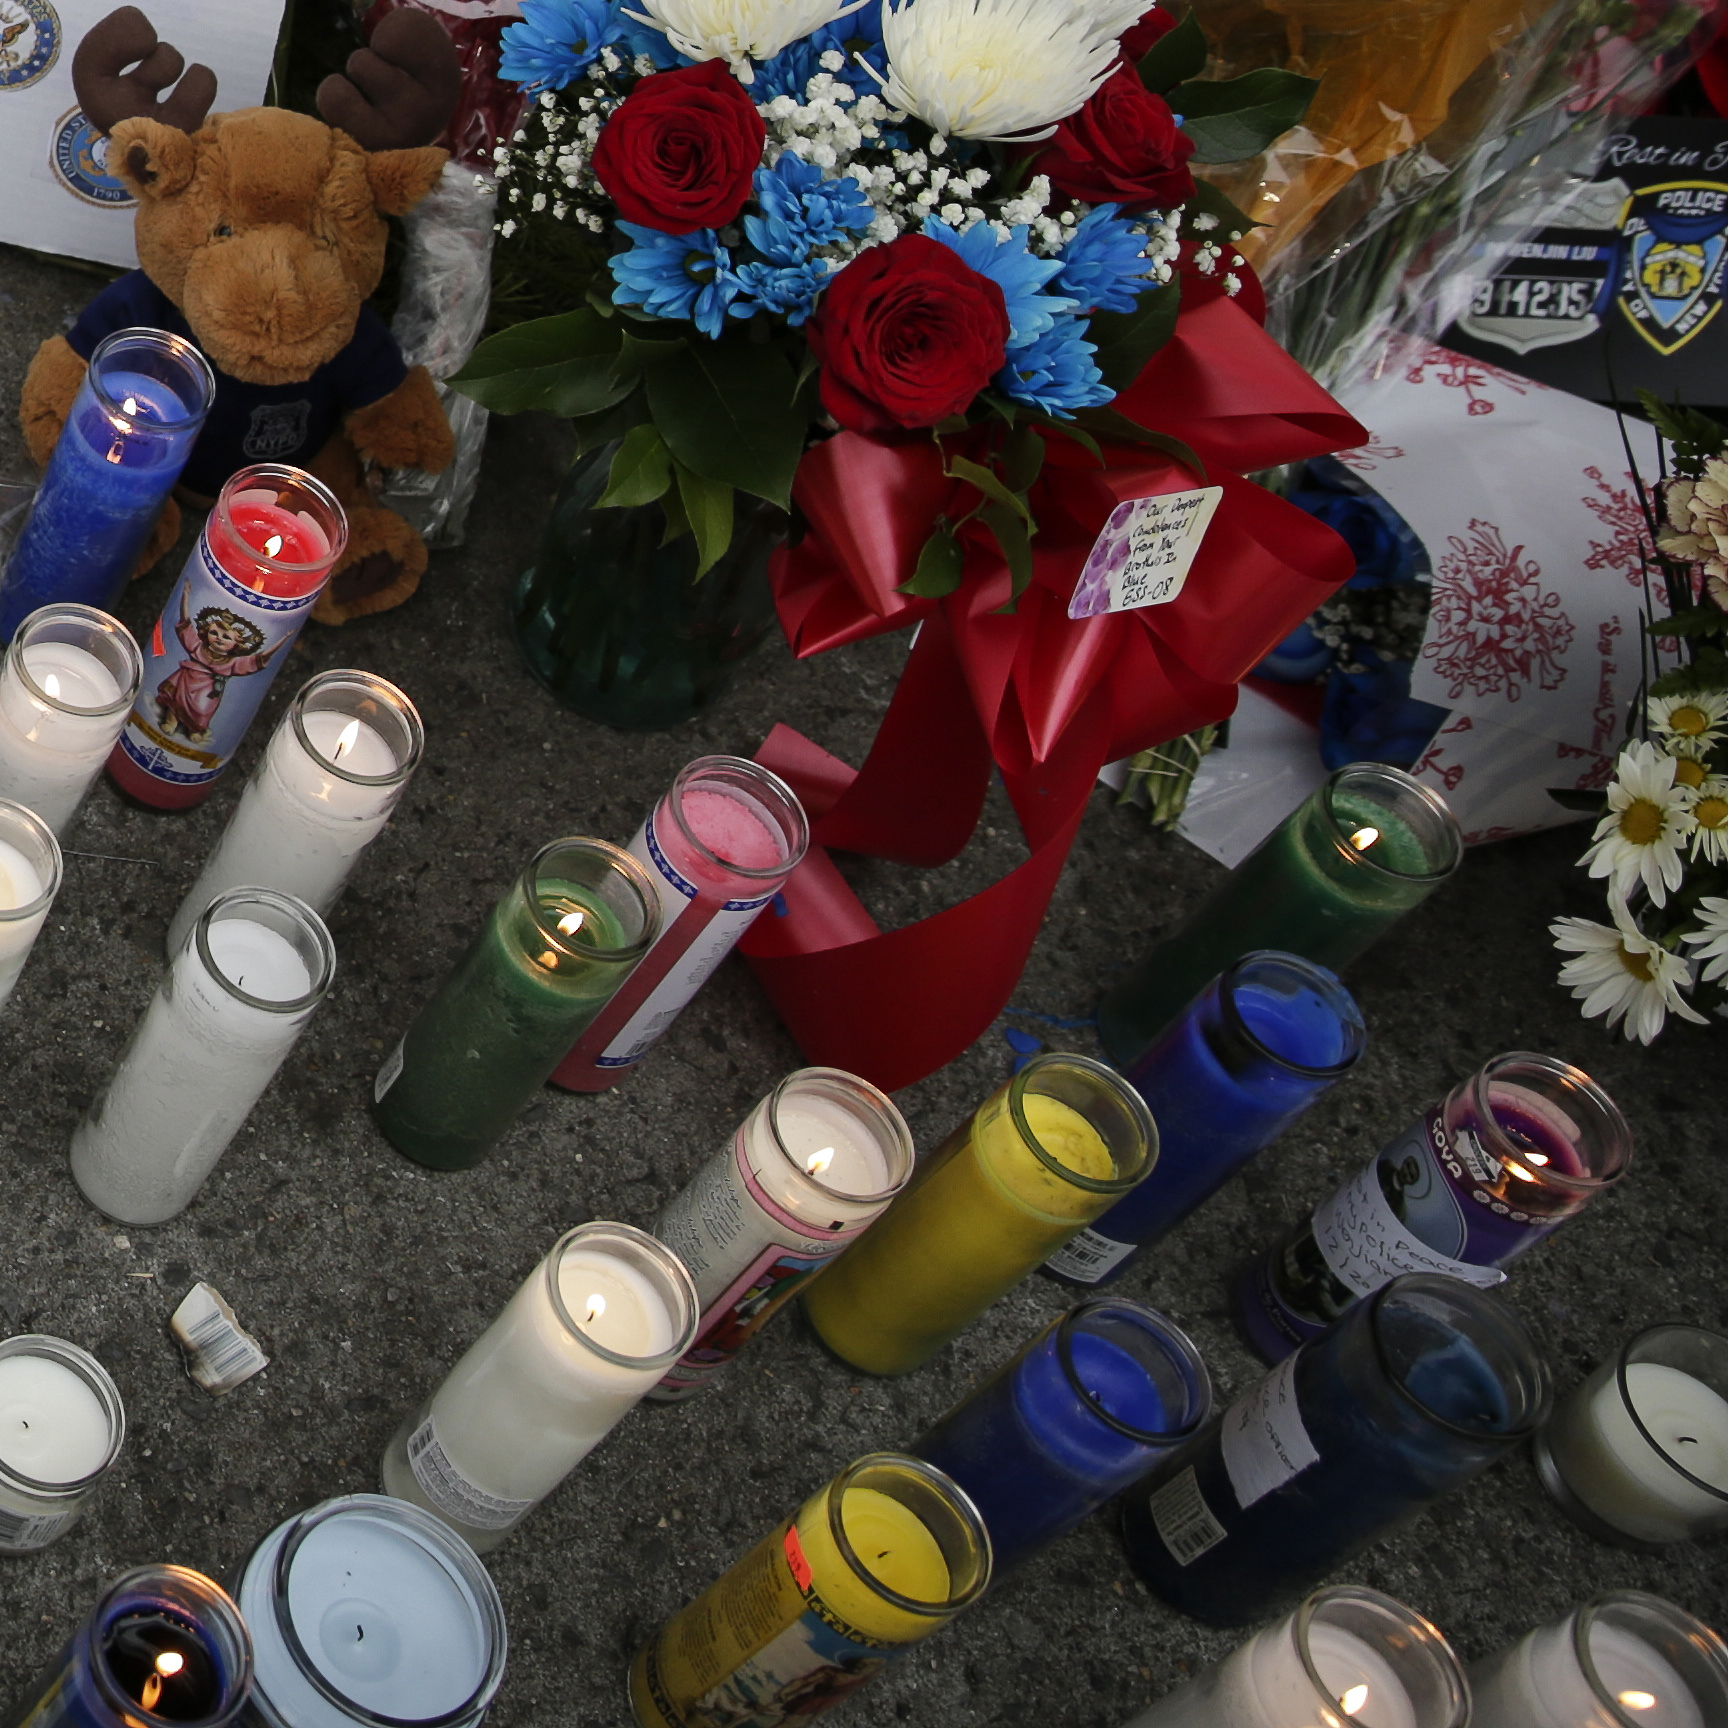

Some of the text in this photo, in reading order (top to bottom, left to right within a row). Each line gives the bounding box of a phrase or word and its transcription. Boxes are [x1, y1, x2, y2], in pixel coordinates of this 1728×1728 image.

[59, 130, 76, 178] UNITED
[1668, 148, 1701, 165] in
[93, 188, 120, 200] 1790
[1657, 190, 1728, 212] POLICE
[1433, 1117, 1462, 1179] GOYA
[1395, 1240, 1464, 1274] Peace
